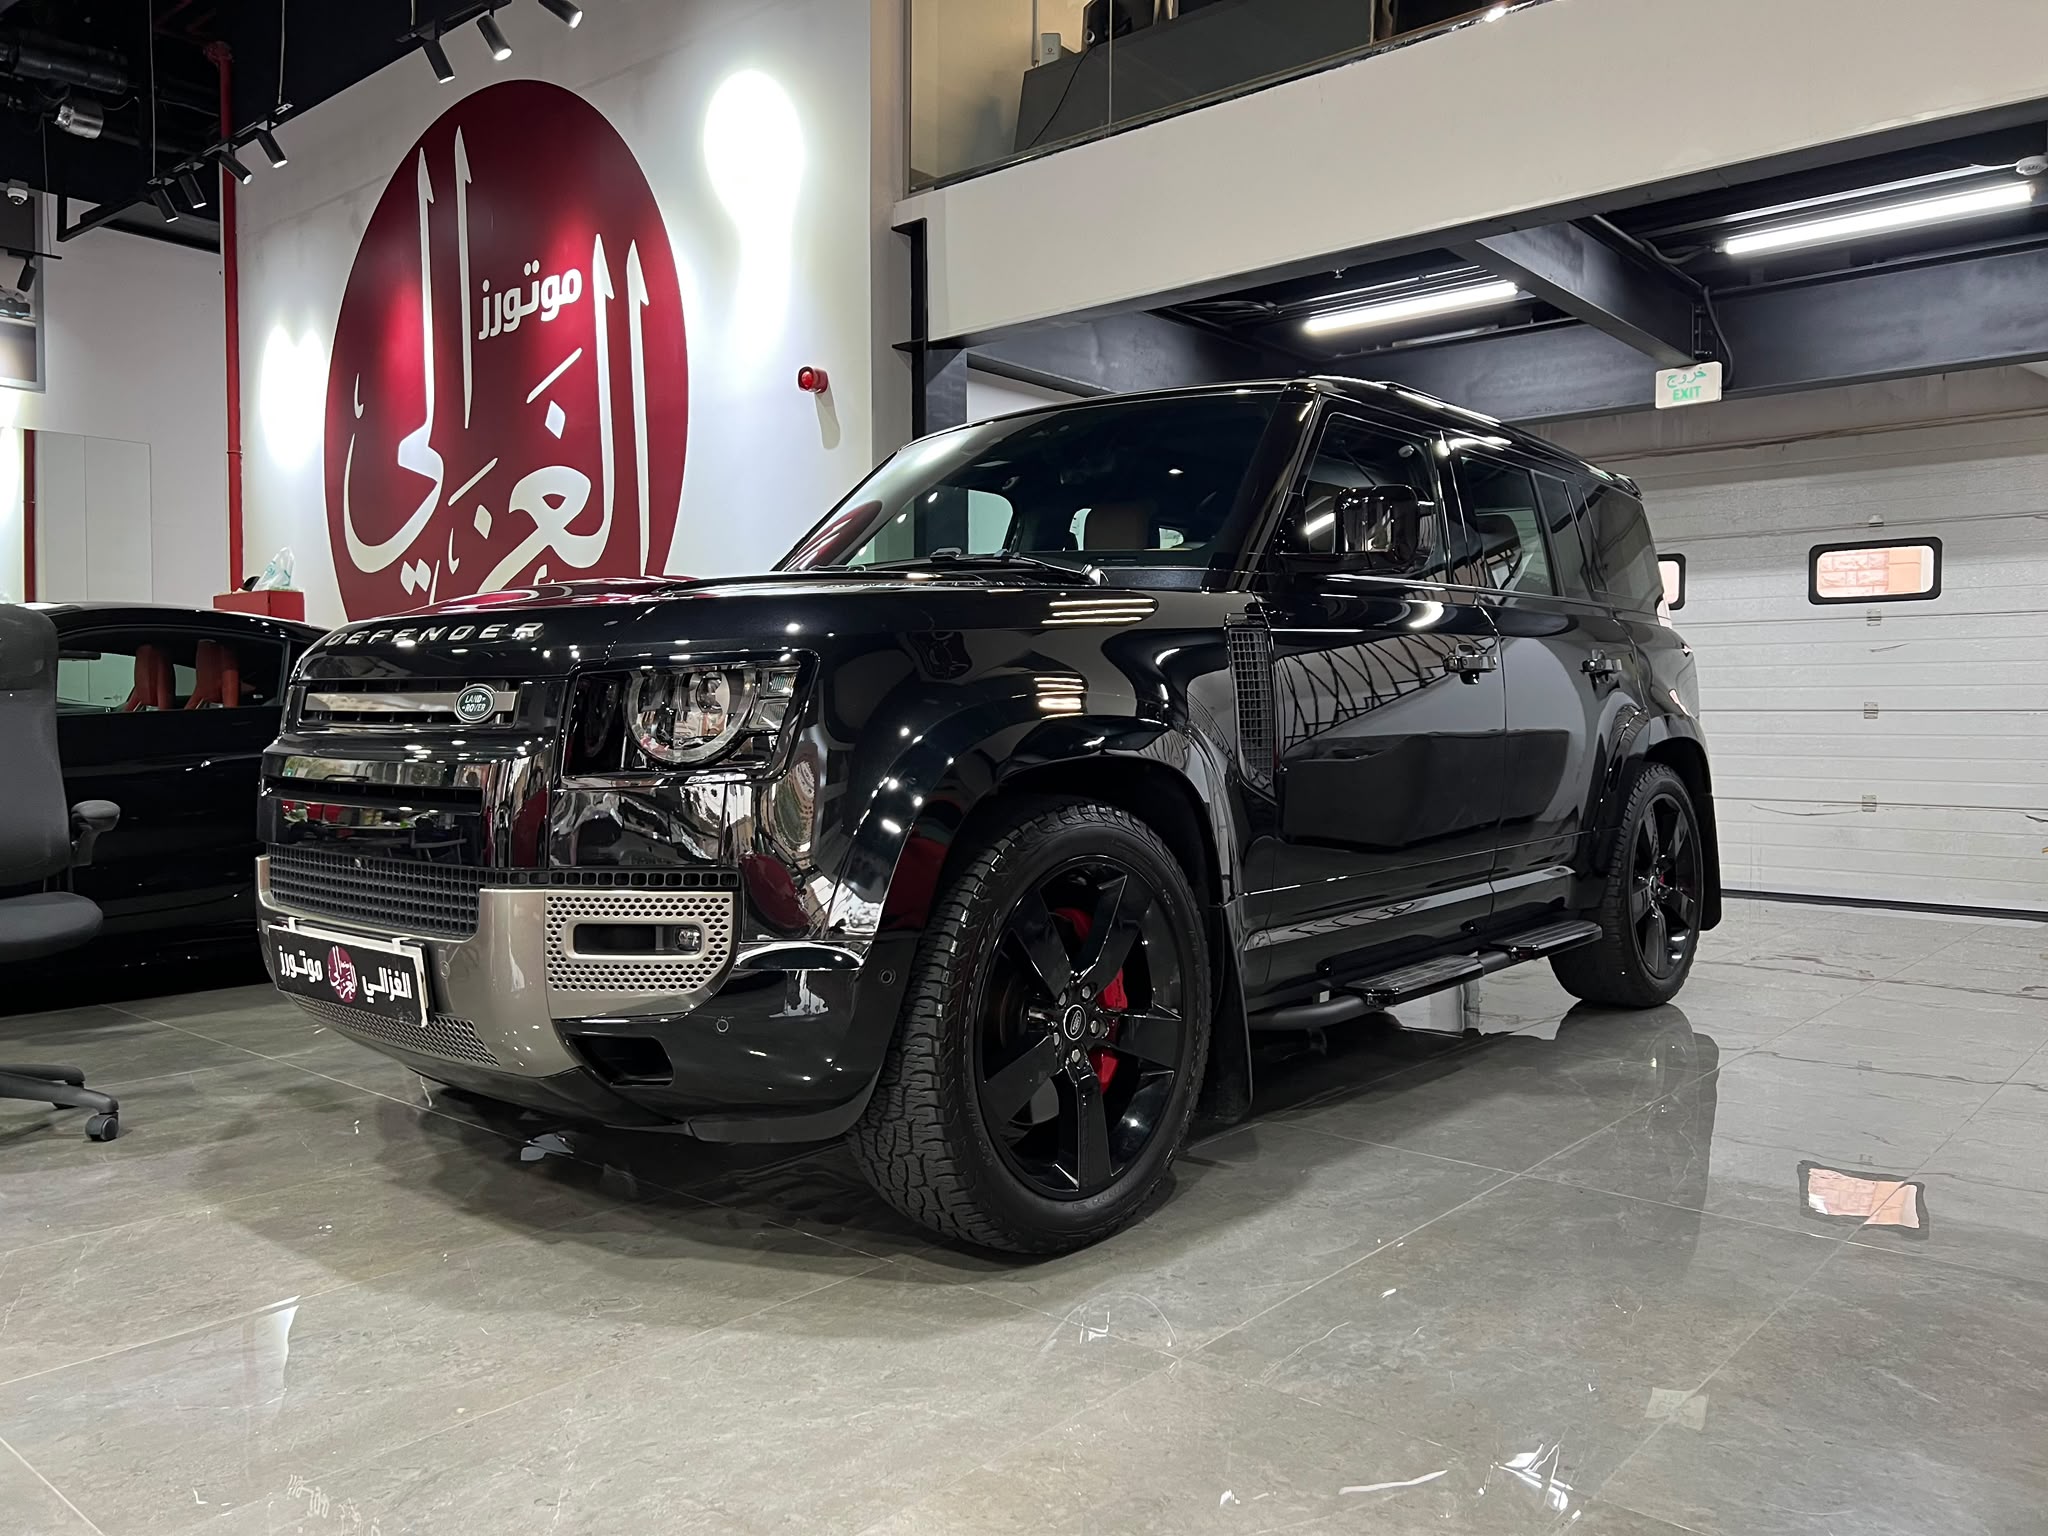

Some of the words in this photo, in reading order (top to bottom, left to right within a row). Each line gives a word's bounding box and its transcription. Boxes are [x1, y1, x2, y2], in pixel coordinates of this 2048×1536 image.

[478, 259, 583, 340] موتورز
[1666, 366, 1707, 389] خروج
[1672, 385, 1702, 401] EXIT
[324, 622, 544, 647] DEFENDER
[464, 694, 483, 704] LAND
[464, 703, 487, 712] ROVER
[278, 944, 324, 983] موتورز
[361, 966, 413, 1004] الغزالي
